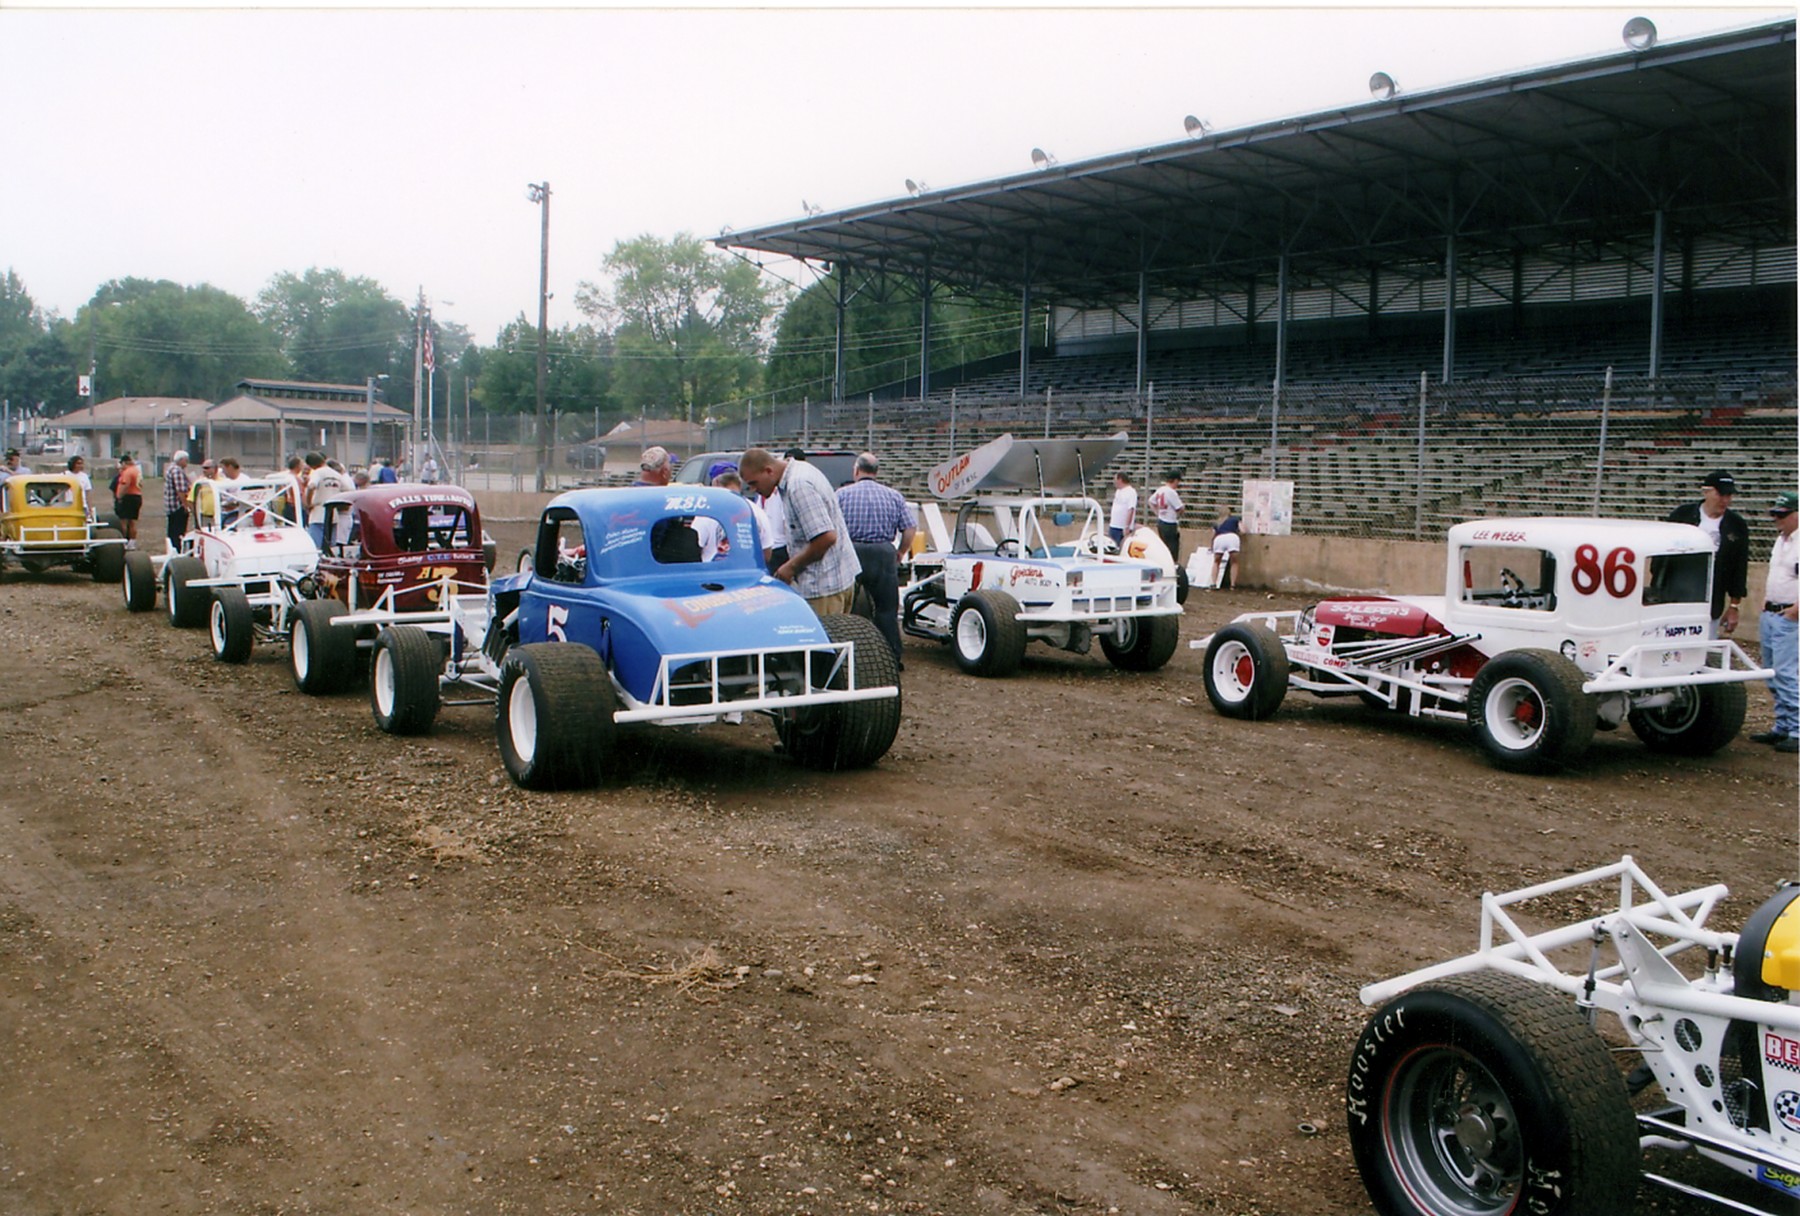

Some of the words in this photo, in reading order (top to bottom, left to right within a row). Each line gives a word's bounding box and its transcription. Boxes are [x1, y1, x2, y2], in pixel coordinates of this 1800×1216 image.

[937, 454, 971, 493] OUTLAW
[388, 495, 421, 508] FALLS
[1473, 530, 1489, 541] LEE
[1491, 531, 1527, 543] WEBER
[1571, 543, 1638, 599] 86
[547, 604, 570, 643] 5
[1665, 626, 1687, 638] HAPPY
[1688, 625, 1704, 636] TAP
[1323, 656, 1347, 669] COMP
[1349, 1006, 1406, 1126] Hoosier
